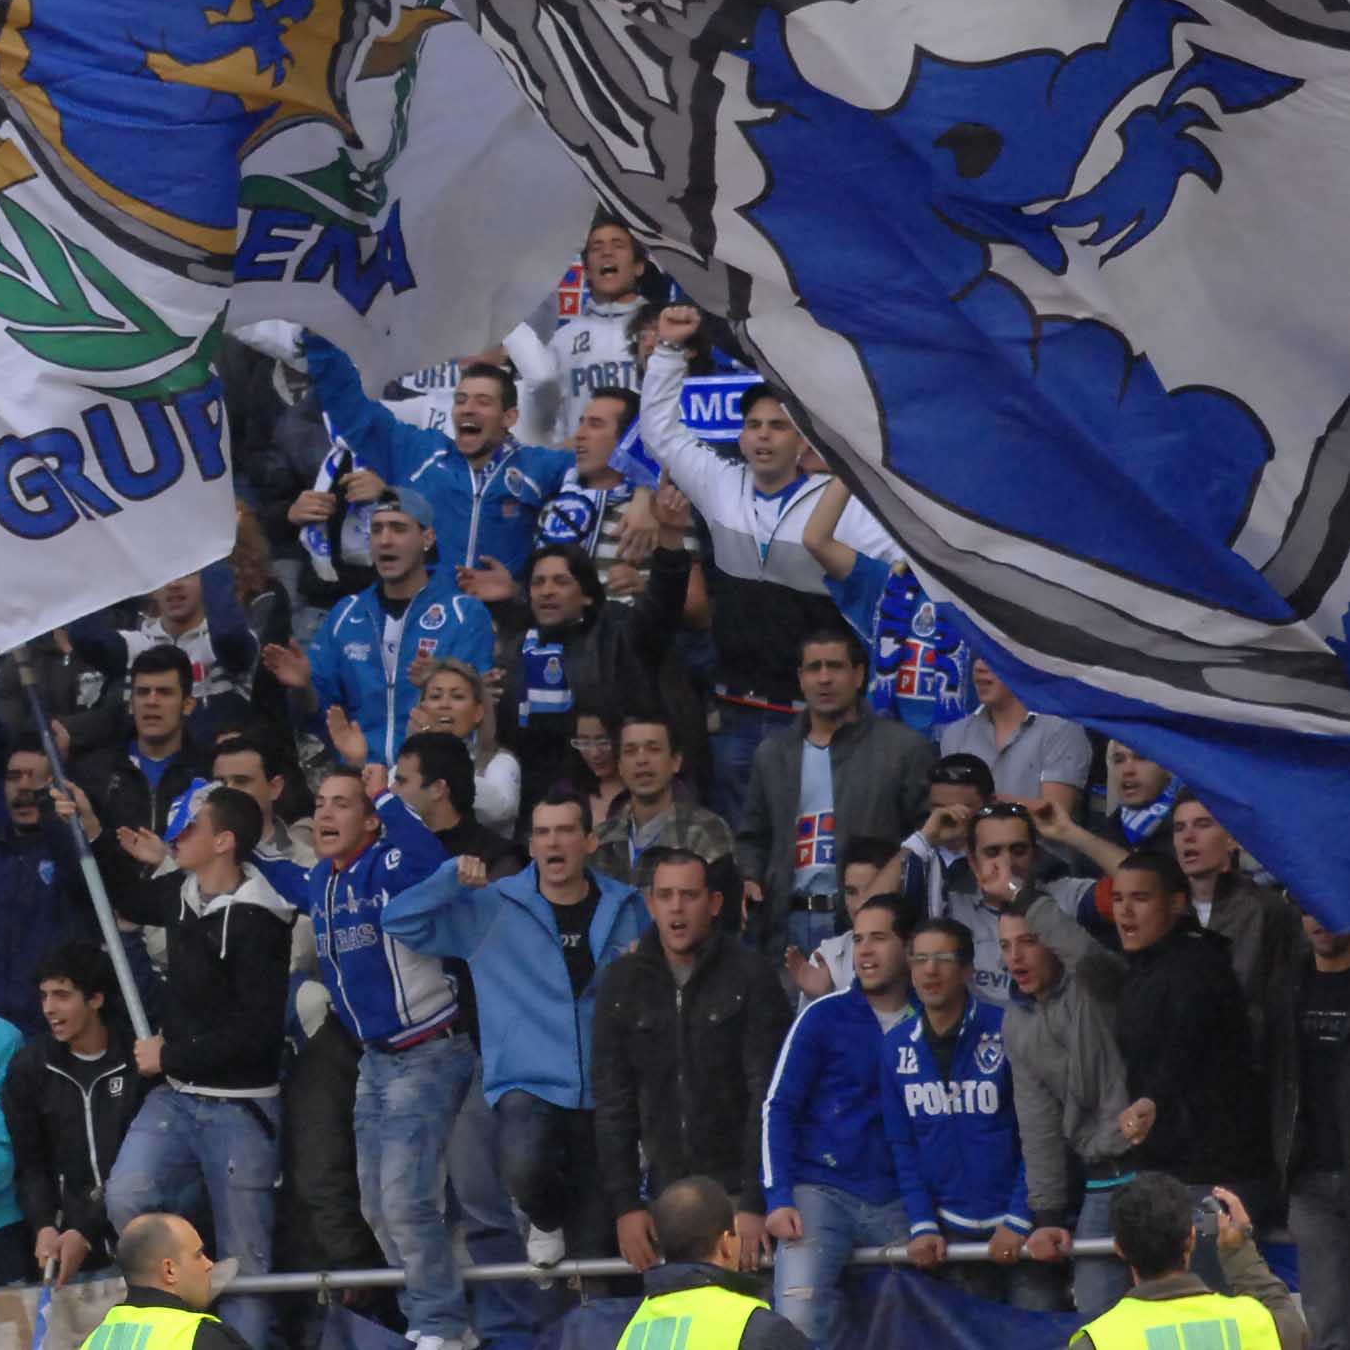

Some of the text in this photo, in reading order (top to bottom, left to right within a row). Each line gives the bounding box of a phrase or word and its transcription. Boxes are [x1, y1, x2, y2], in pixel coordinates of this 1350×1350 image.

[571, 330, 591, 355] 12
[896, 1047, 920, 1075] 12
[904, 1080, 999, 1118] PORTO
